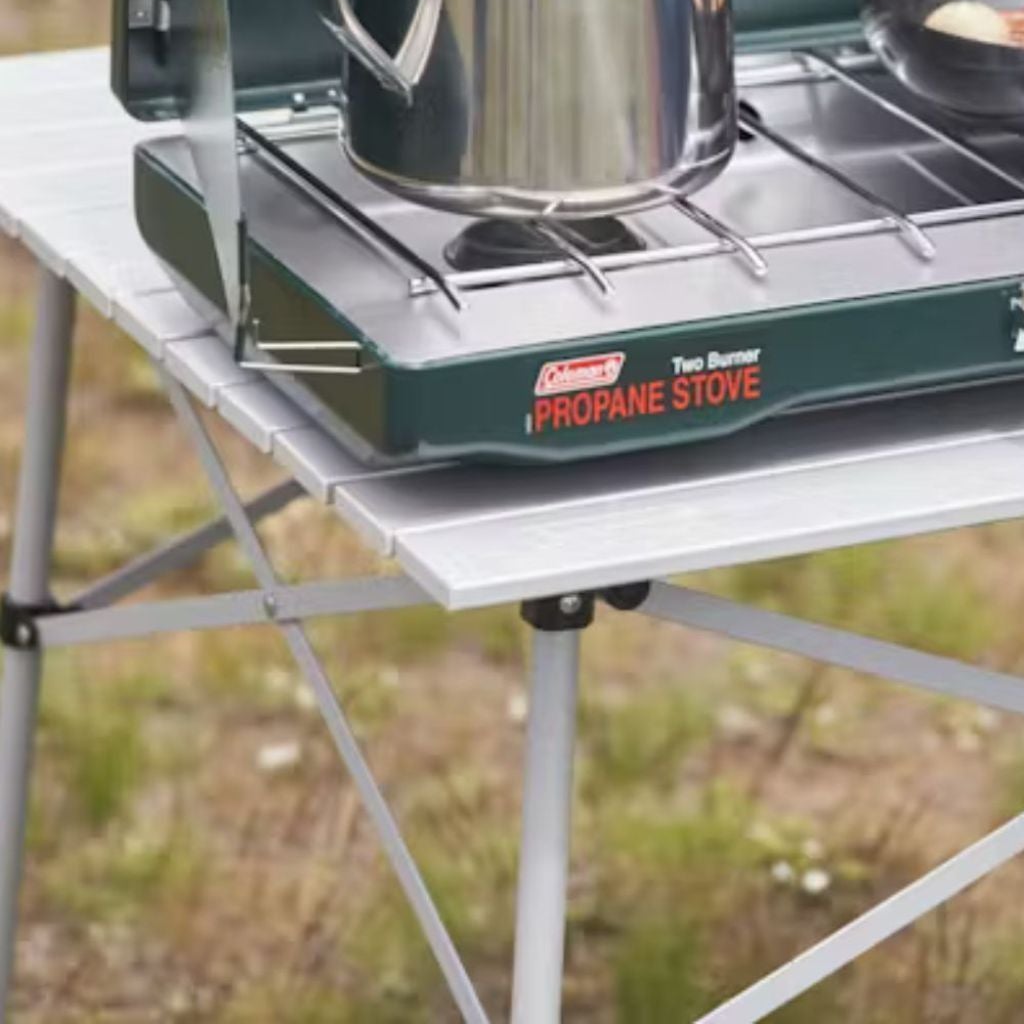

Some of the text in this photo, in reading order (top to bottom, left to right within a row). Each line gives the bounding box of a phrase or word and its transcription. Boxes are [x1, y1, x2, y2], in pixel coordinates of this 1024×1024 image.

[672, 347, 761, 375] Two Burner
[534, 380, 664, 431] PROPANE
[672, 365, 761, 410] STOVE
